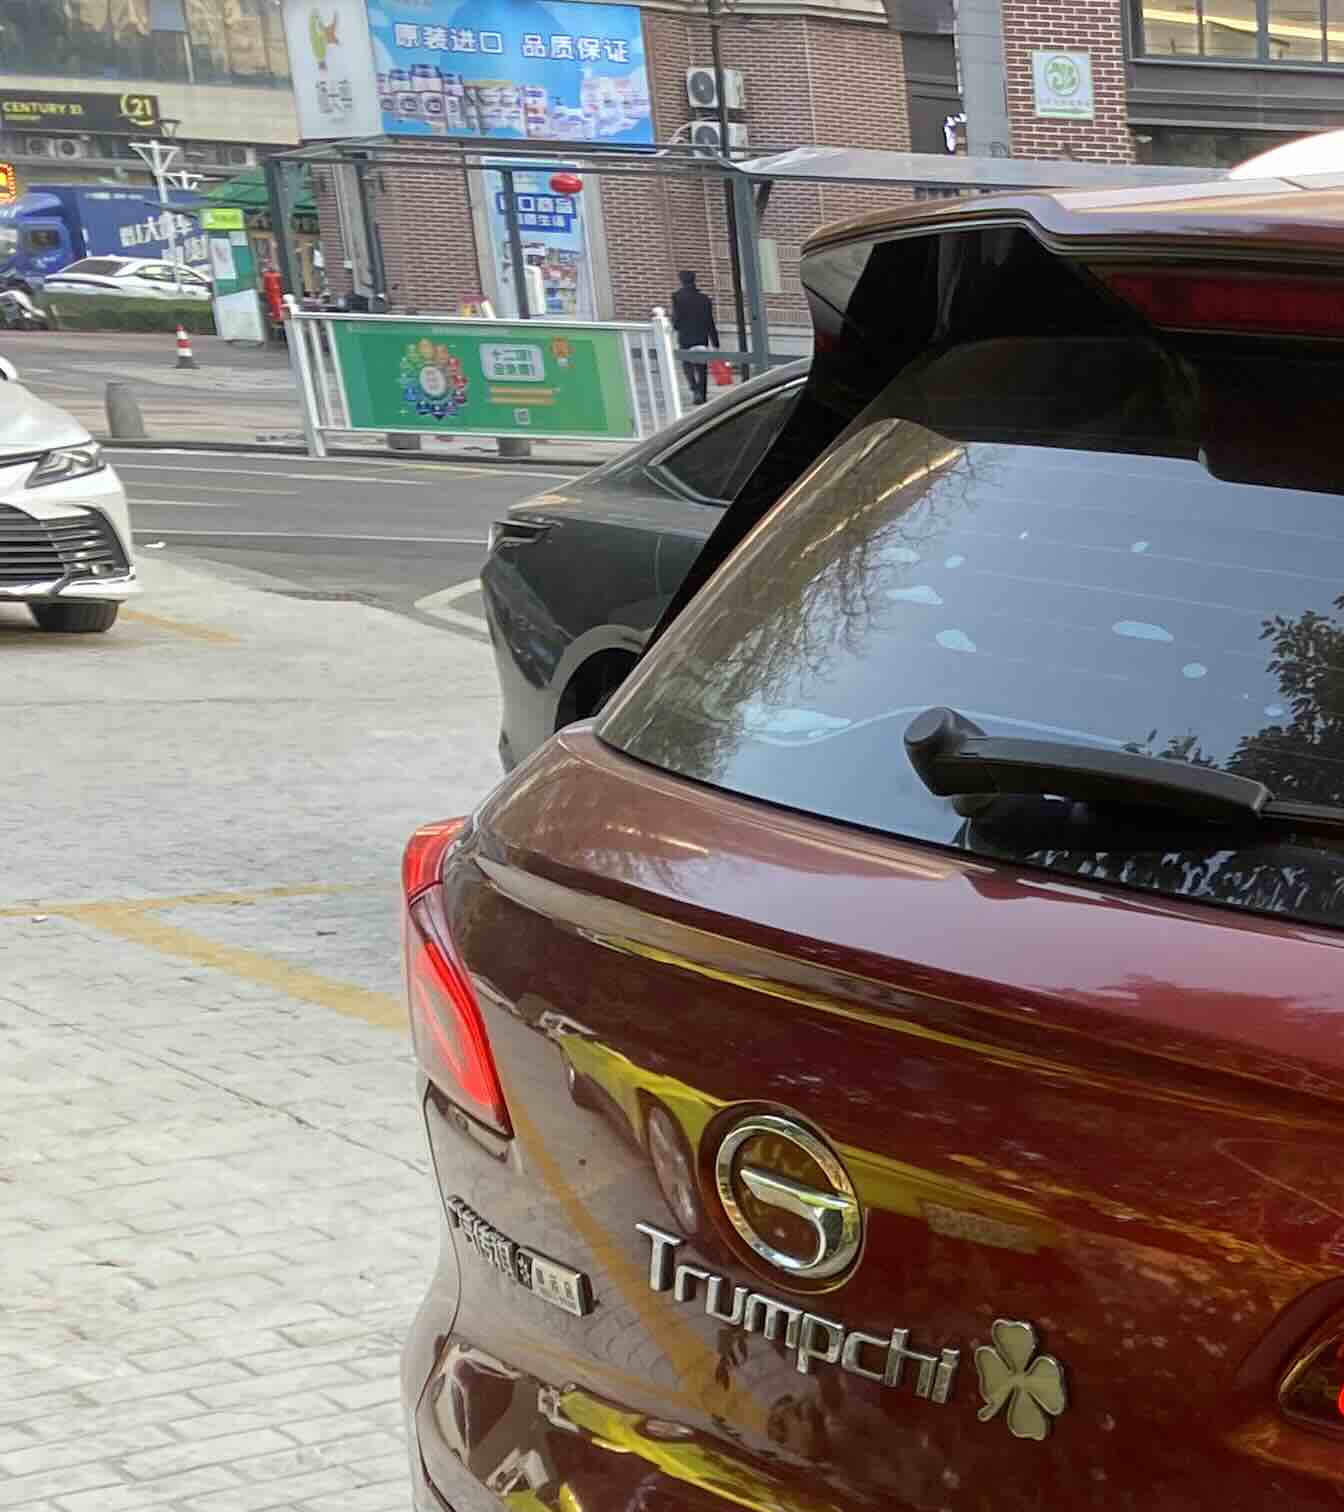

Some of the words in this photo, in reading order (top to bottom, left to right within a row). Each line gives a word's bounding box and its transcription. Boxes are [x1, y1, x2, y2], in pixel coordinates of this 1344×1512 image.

[393, 23, 504, 54] 原装进口
[521, 33, 629, 64] 品质保证
[635, 1223, 960, 1404] Trumpchi
